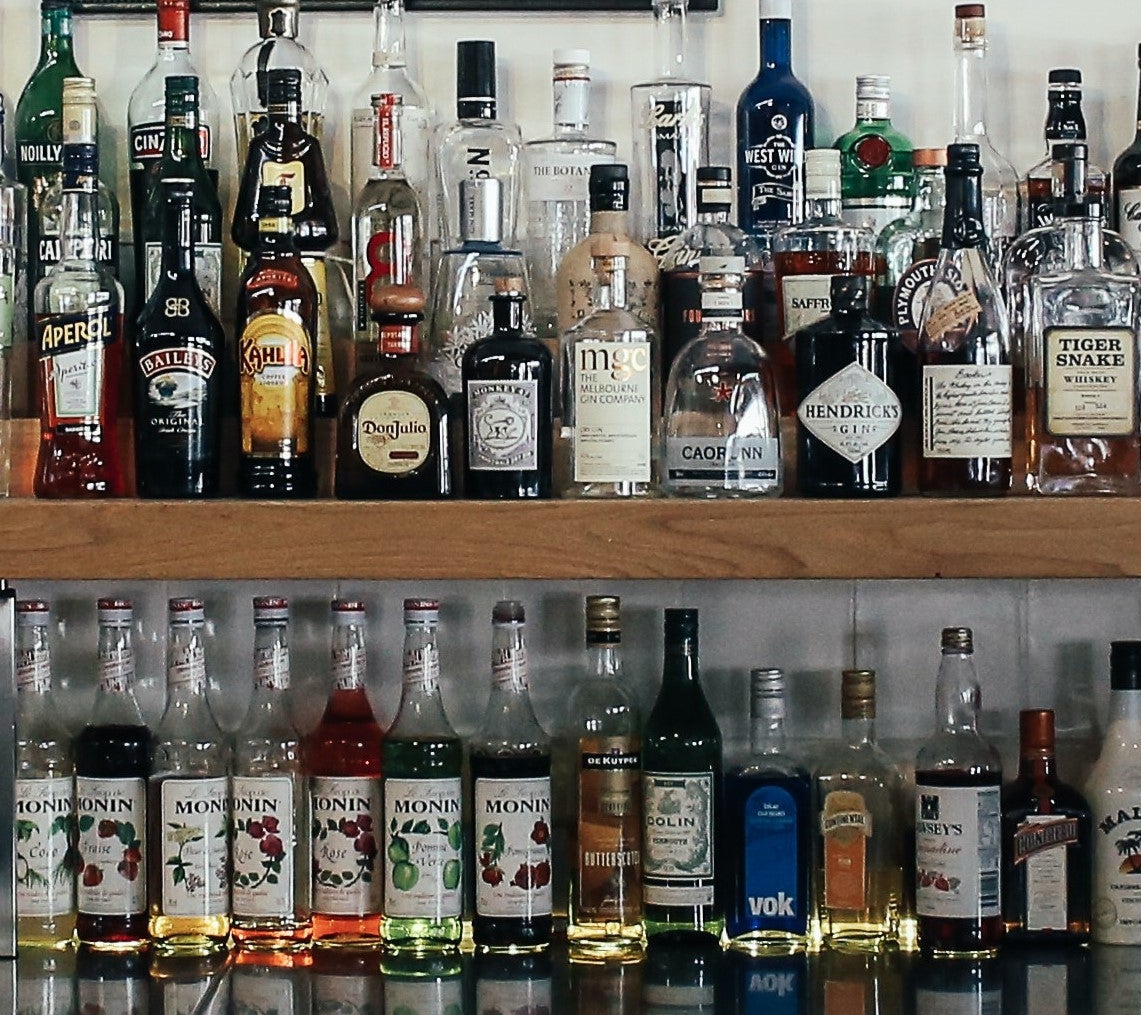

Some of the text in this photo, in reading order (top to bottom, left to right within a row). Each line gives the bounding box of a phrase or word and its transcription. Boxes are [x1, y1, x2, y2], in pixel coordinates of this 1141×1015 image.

[21, 144, 62, 162] NOILLY
[745, 150, 774, 163] WEST
[42, 317, 111, 351] APEROL
[1059, 338, 1121, 351] TIGER
[145, 352, 212, 375] BAILEYS
[581, 348, 647, 382] mgc
[1056, 354, 1125, 366] SNAKE
[580, 373, 598, 382] THE
[1063, 375, 1117, 384] WHISKEY
[580, 395, 597, 404] GIN
[806, 404, 899, 419] HENDRICK'S
[839, 425, 873, 434] GIN
[395, 799, 461, 813] MONIN
[485, 799, 550, 813] MONIN
[748, 892, 795, 917] vok
